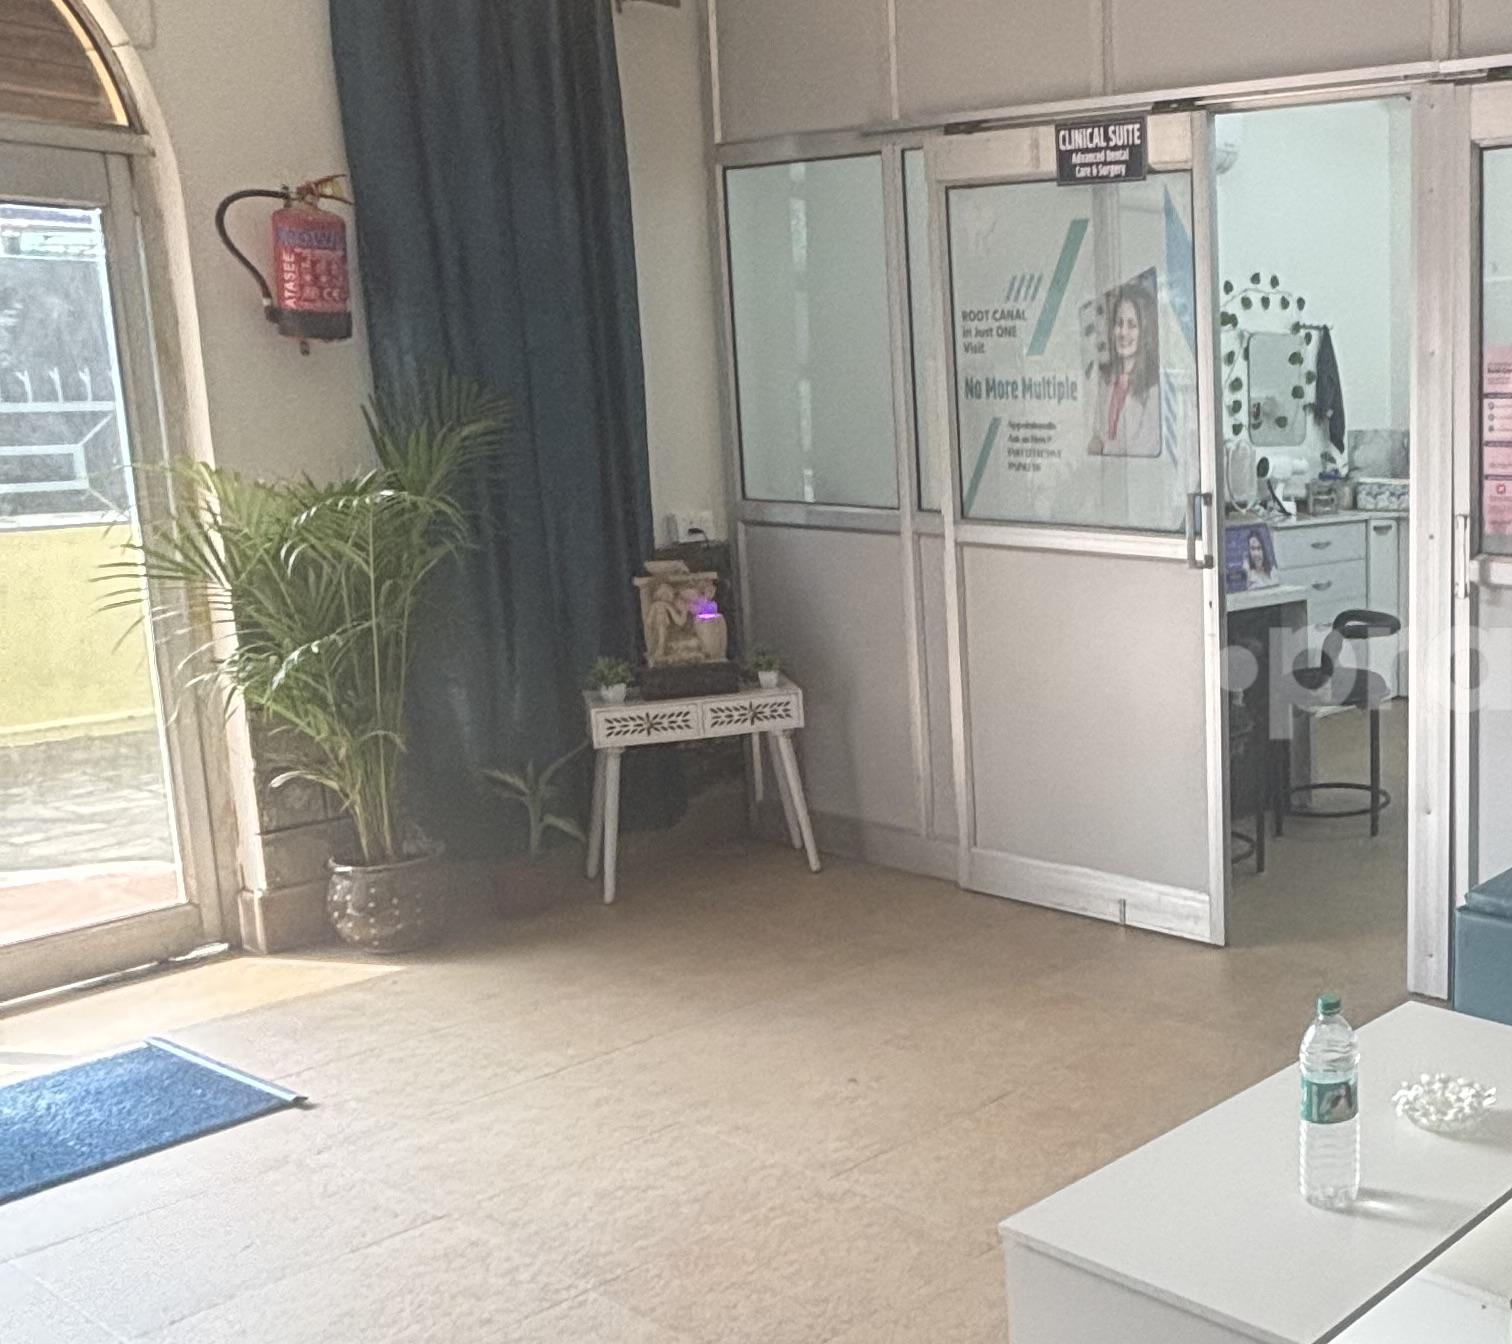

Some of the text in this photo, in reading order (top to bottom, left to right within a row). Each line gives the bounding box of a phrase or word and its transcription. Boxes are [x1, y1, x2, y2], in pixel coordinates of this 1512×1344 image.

[1059, 123, 1141, 151] CLINICAL SUITE
[1075, 165, 1091, 177] Care
[1098, 164, 1126, 178] Surgery
[961, 308, 1027, 323] ROOT CANAL
[996, 324, 1017, 338] ONE
[965, 373, 1079, 404] No More Multiple
